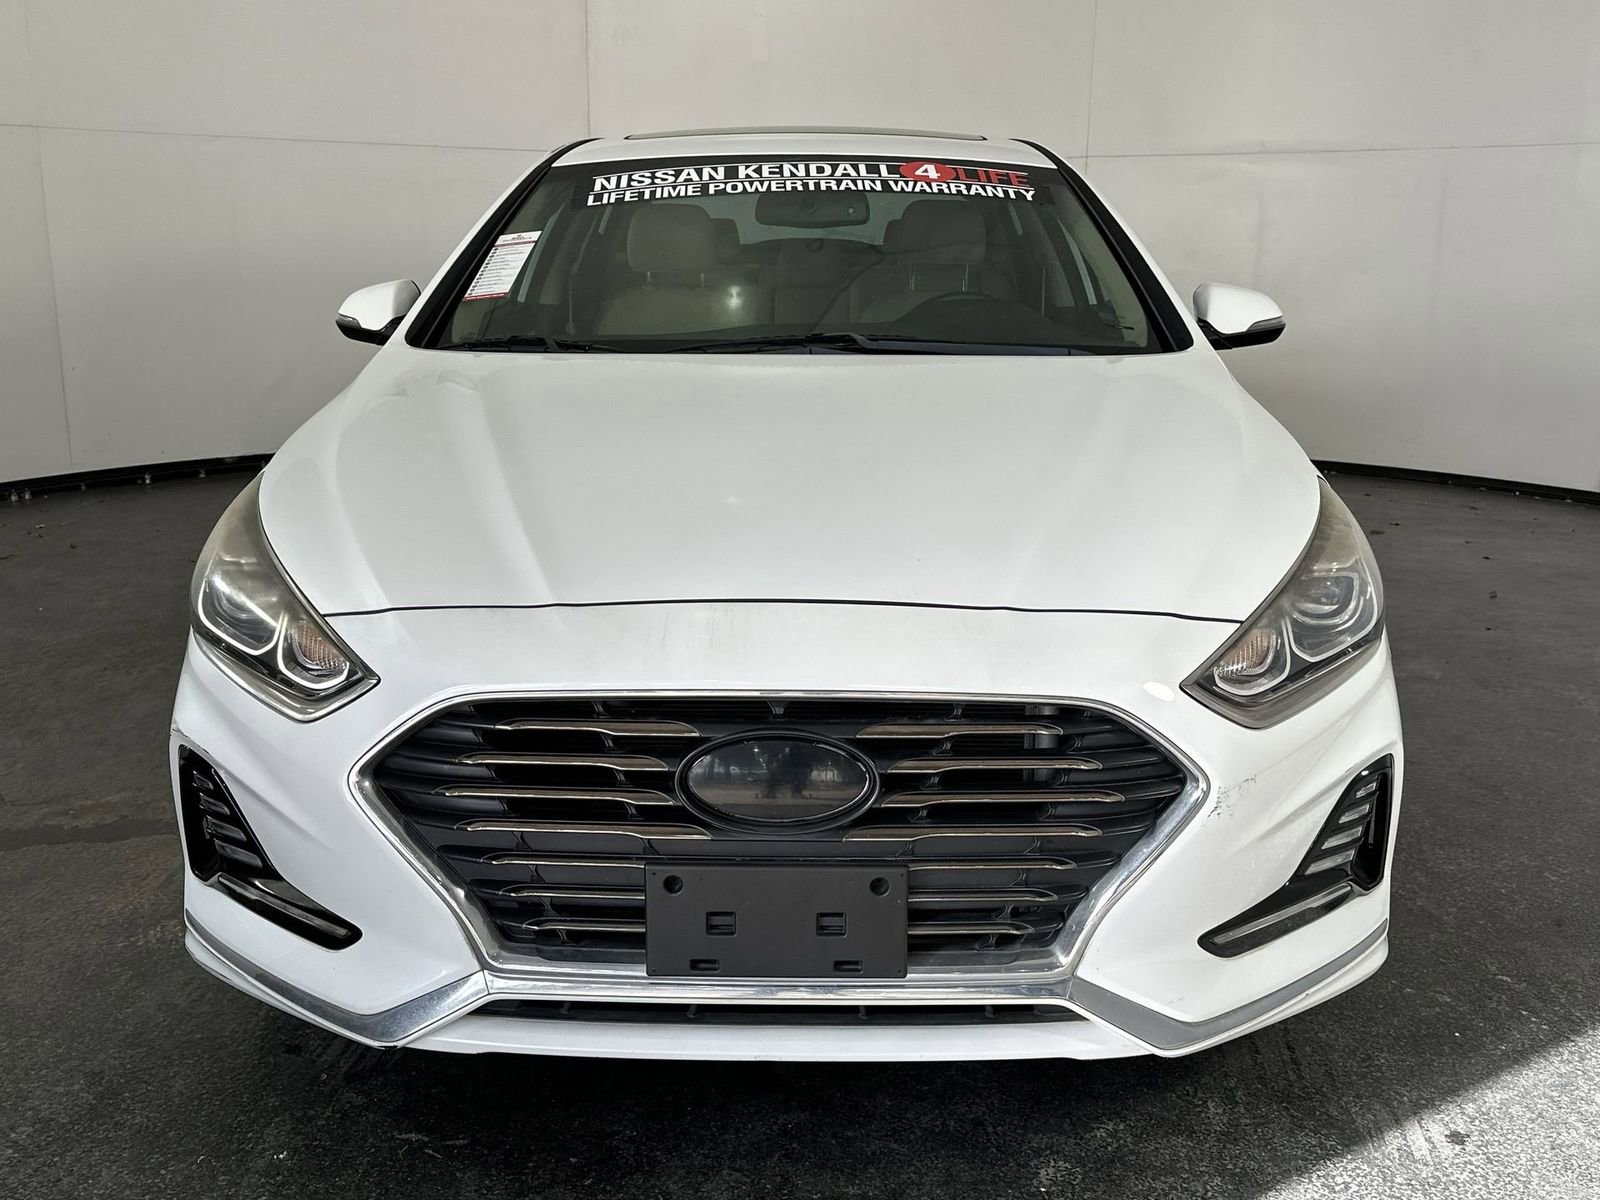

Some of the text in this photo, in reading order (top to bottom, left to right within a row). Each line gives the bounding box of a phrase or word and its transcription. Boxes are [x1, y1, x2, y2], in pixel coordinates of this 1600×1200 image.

[593, 163, 1030, 192] NISSAN KENDALL 4 LIFE
[586, 178, 1035, 207] LIFETIME POWERTRAIN WARRANTY
